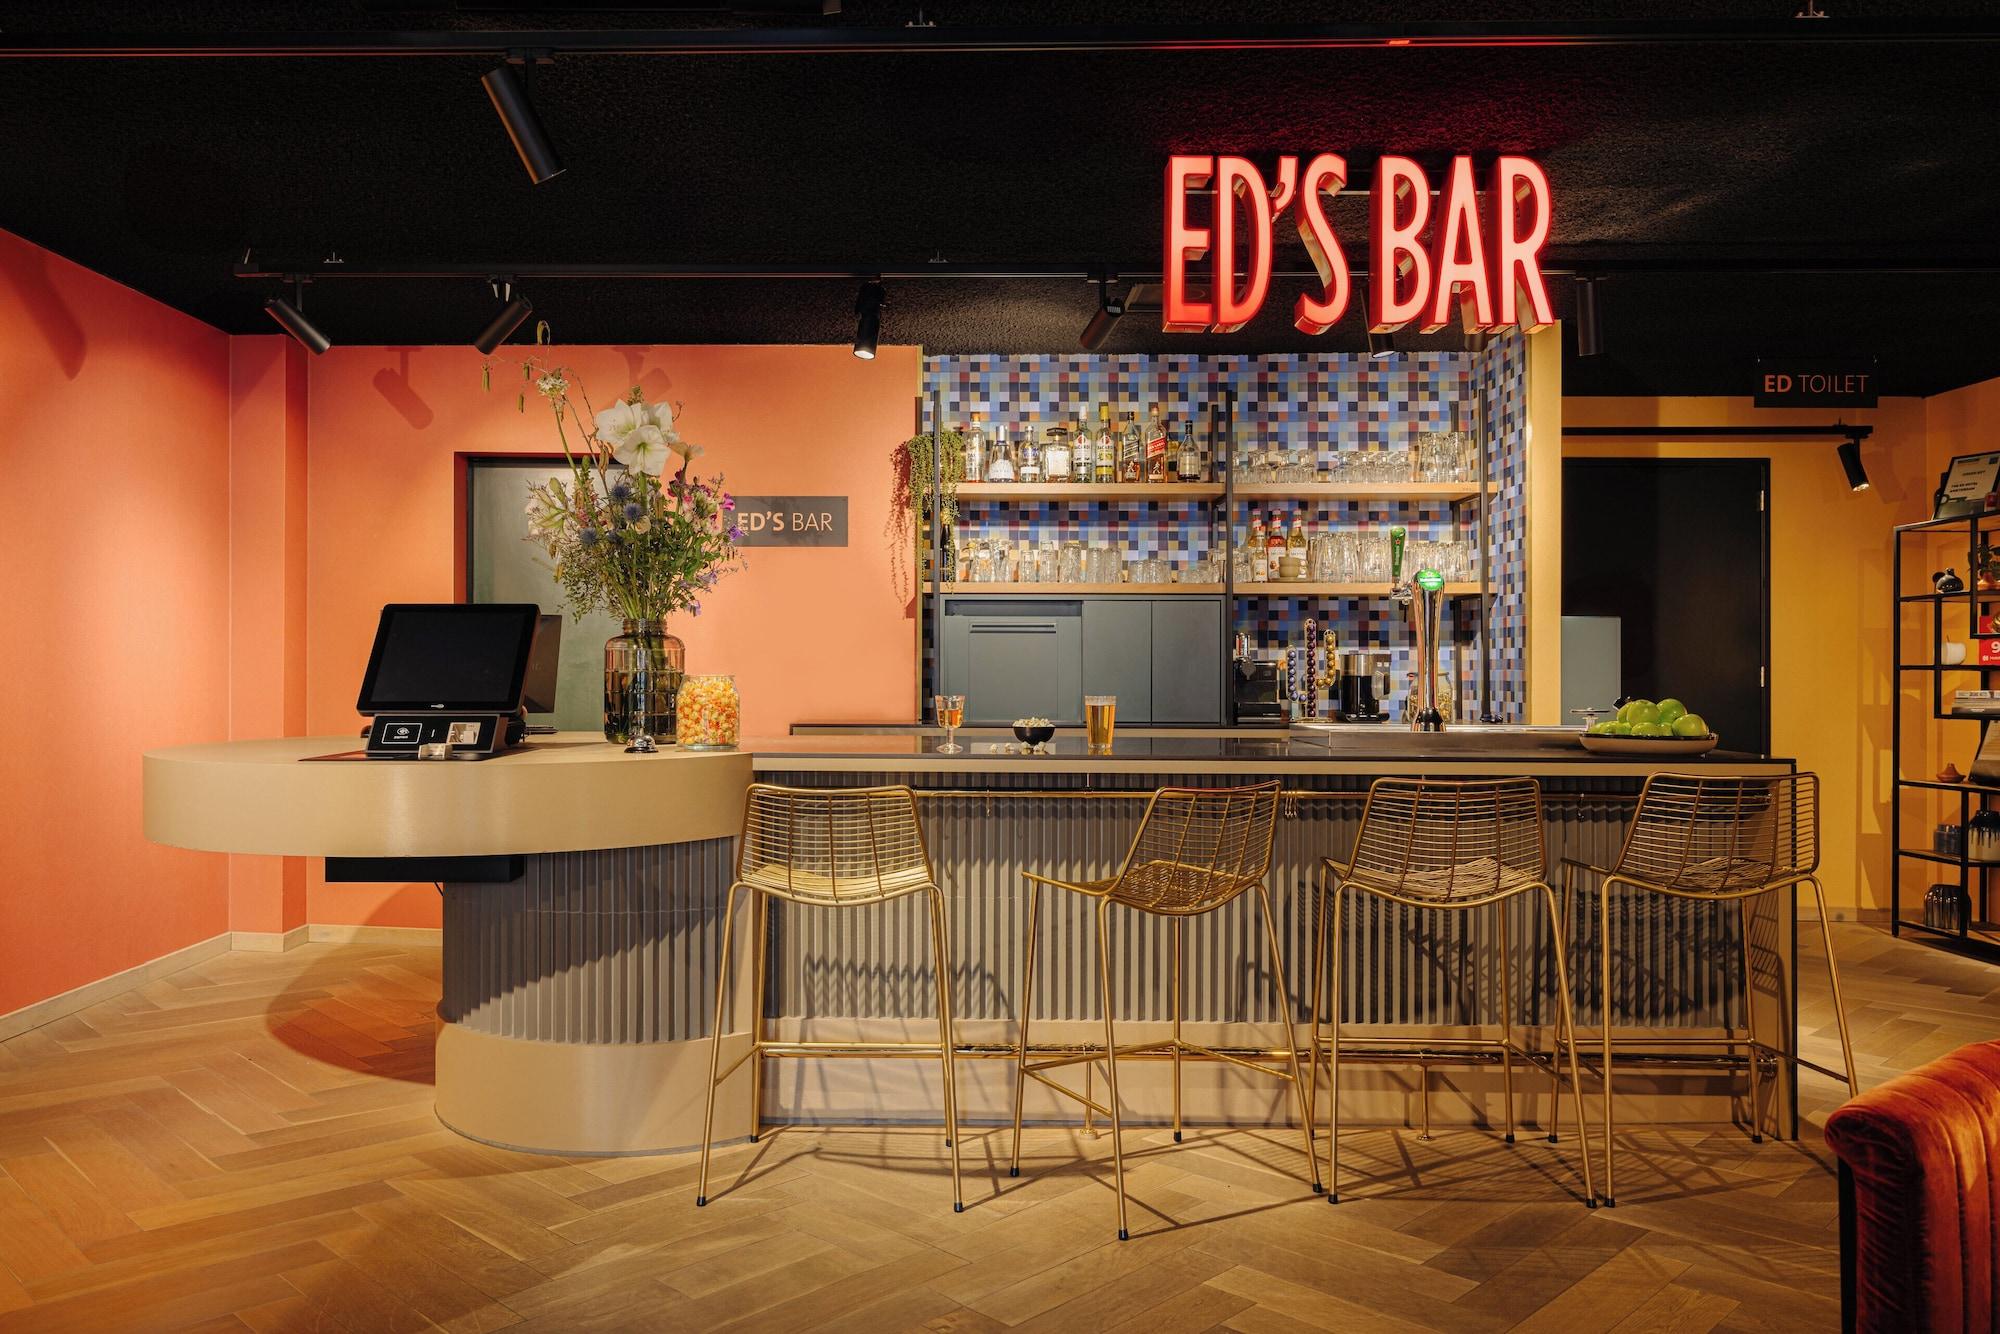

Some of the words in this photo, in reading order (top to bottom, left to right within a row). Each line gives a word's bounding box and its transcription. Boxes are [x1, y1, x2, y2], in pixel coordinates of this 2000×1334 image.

[1164, 154, 1350, 331] ED'S
[1371, 155, 1556, 331] BAR
[1764, 374, 1793, 393] ED
[1798, 374, 1870, 393] TOILET
[737, 511, 785, 532] ED'S
[792, 512, 833, 531] BAR
